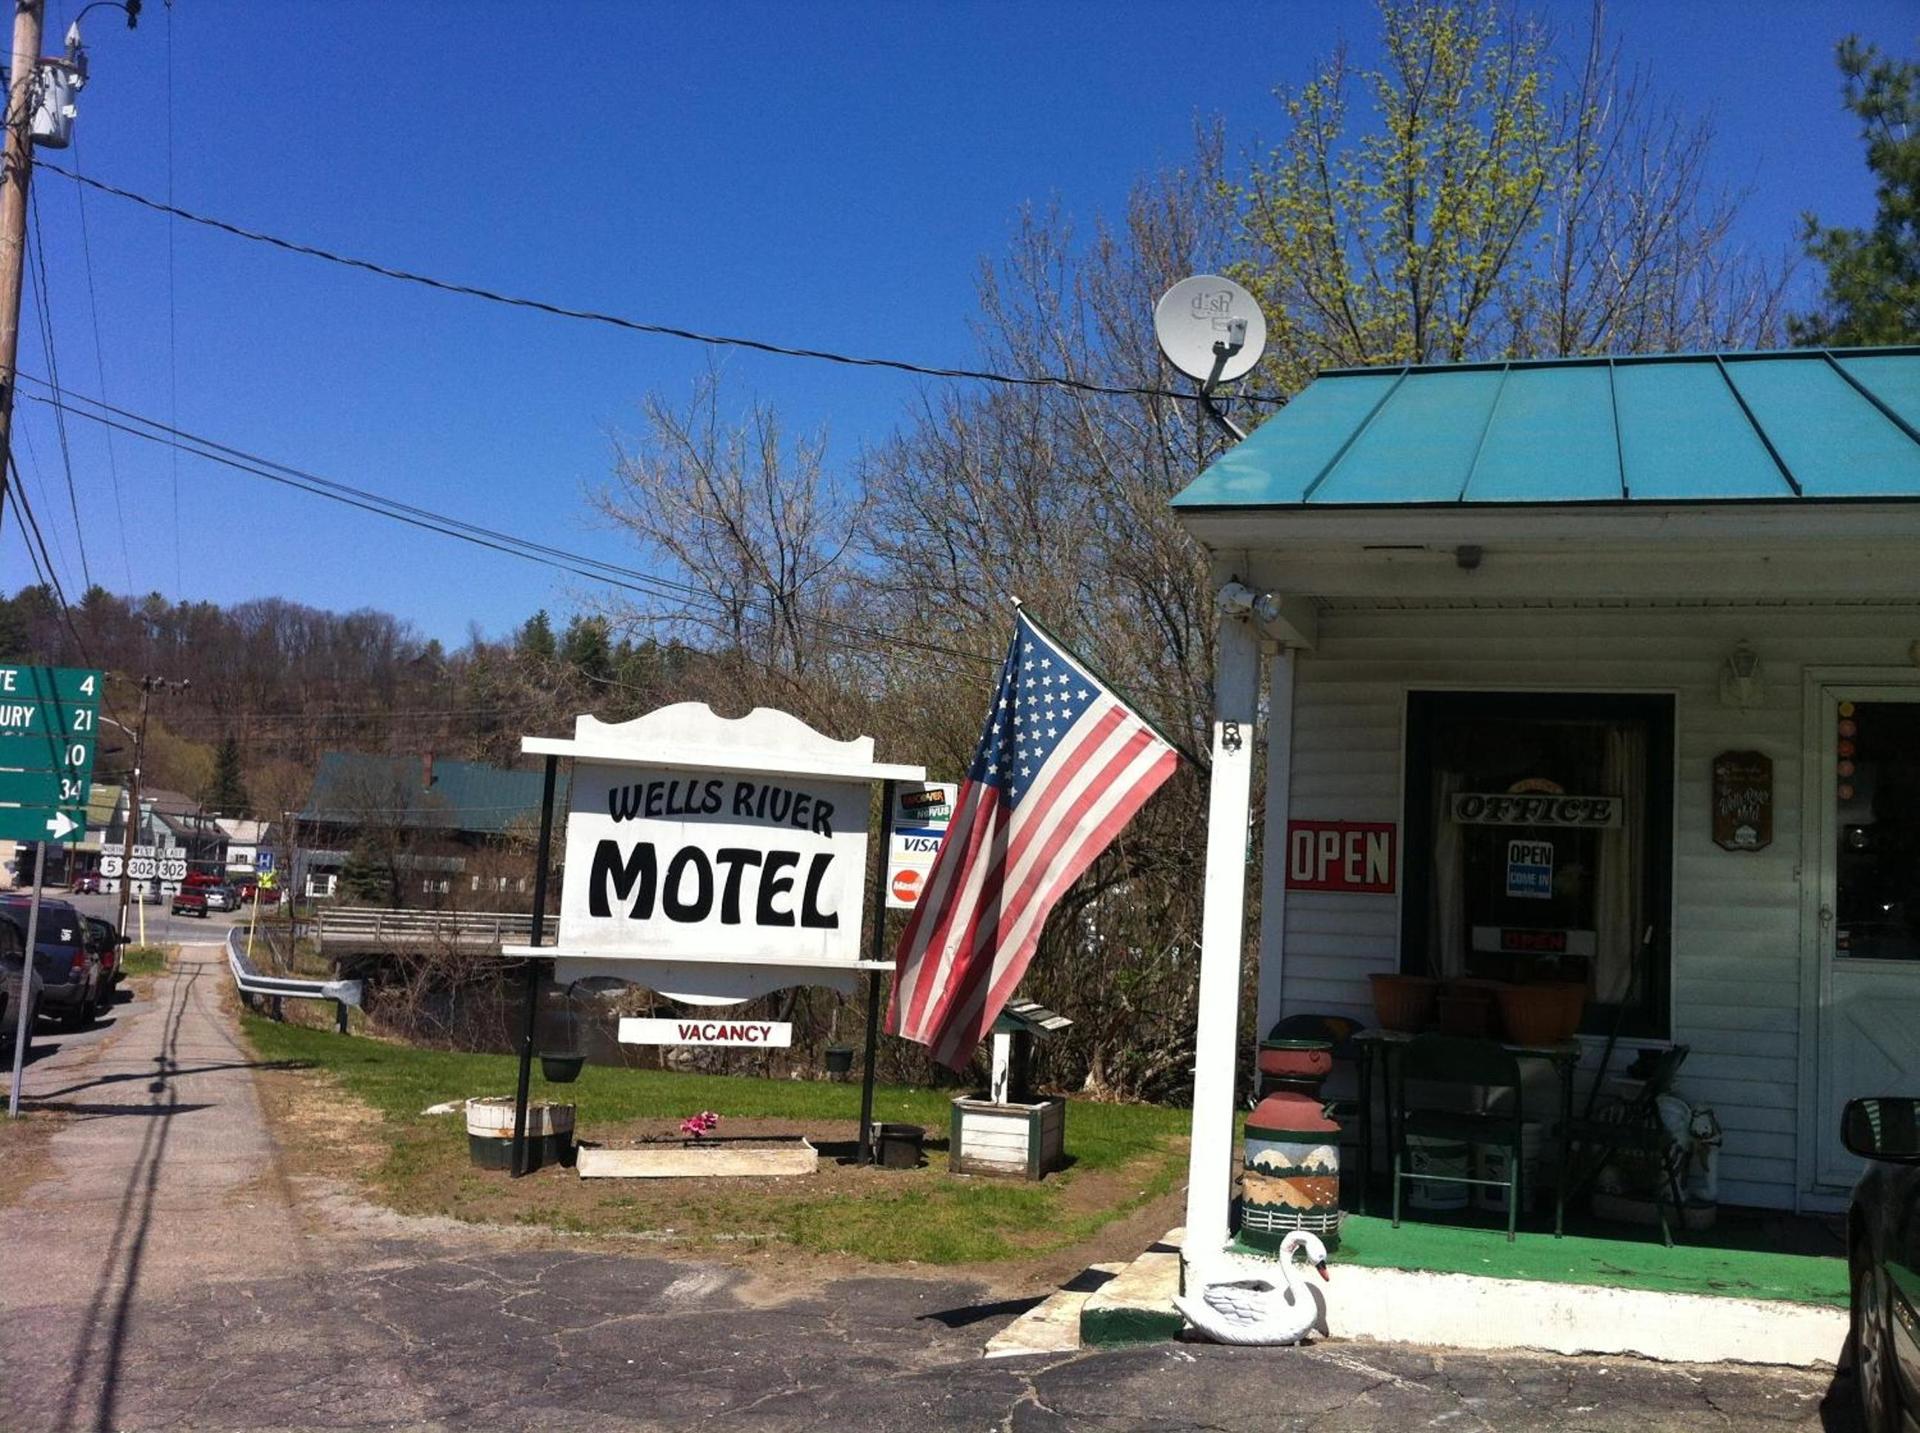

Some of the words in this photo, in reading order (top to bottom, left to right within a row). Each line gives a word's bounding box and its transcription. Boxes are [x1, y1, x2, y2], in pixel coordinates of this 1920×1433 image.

[1192, 291, 1229, 313] dish
[80, 675, 95, 696] 4
[73, 709, 92, 731] 21
[64, 744, 86, 766] 10
[59, 779, 82, 801] 34
[608, 779, 723, 823] WELLS
[732, 783, 835, 839] RIVER
[1456, 796, 1612, 824] OFFICE
[903, 837, 940, 852] VISA
[1511, 844, 1552, 865] OPEN
[107, 861, 116, 873] 5
[260, 855, 271, 868] H
[1290, 829, 1390, 885] OPEN
[130, 862, 153, 875] 302
[161, 863, 184, 877] 302
[588, 838, 839, 930] MOTEL
[1510, 872, 1537, 886] COME
[1539, 873, 1549, 887] IN
[678, 1024, 771, 1042] VACANCY
